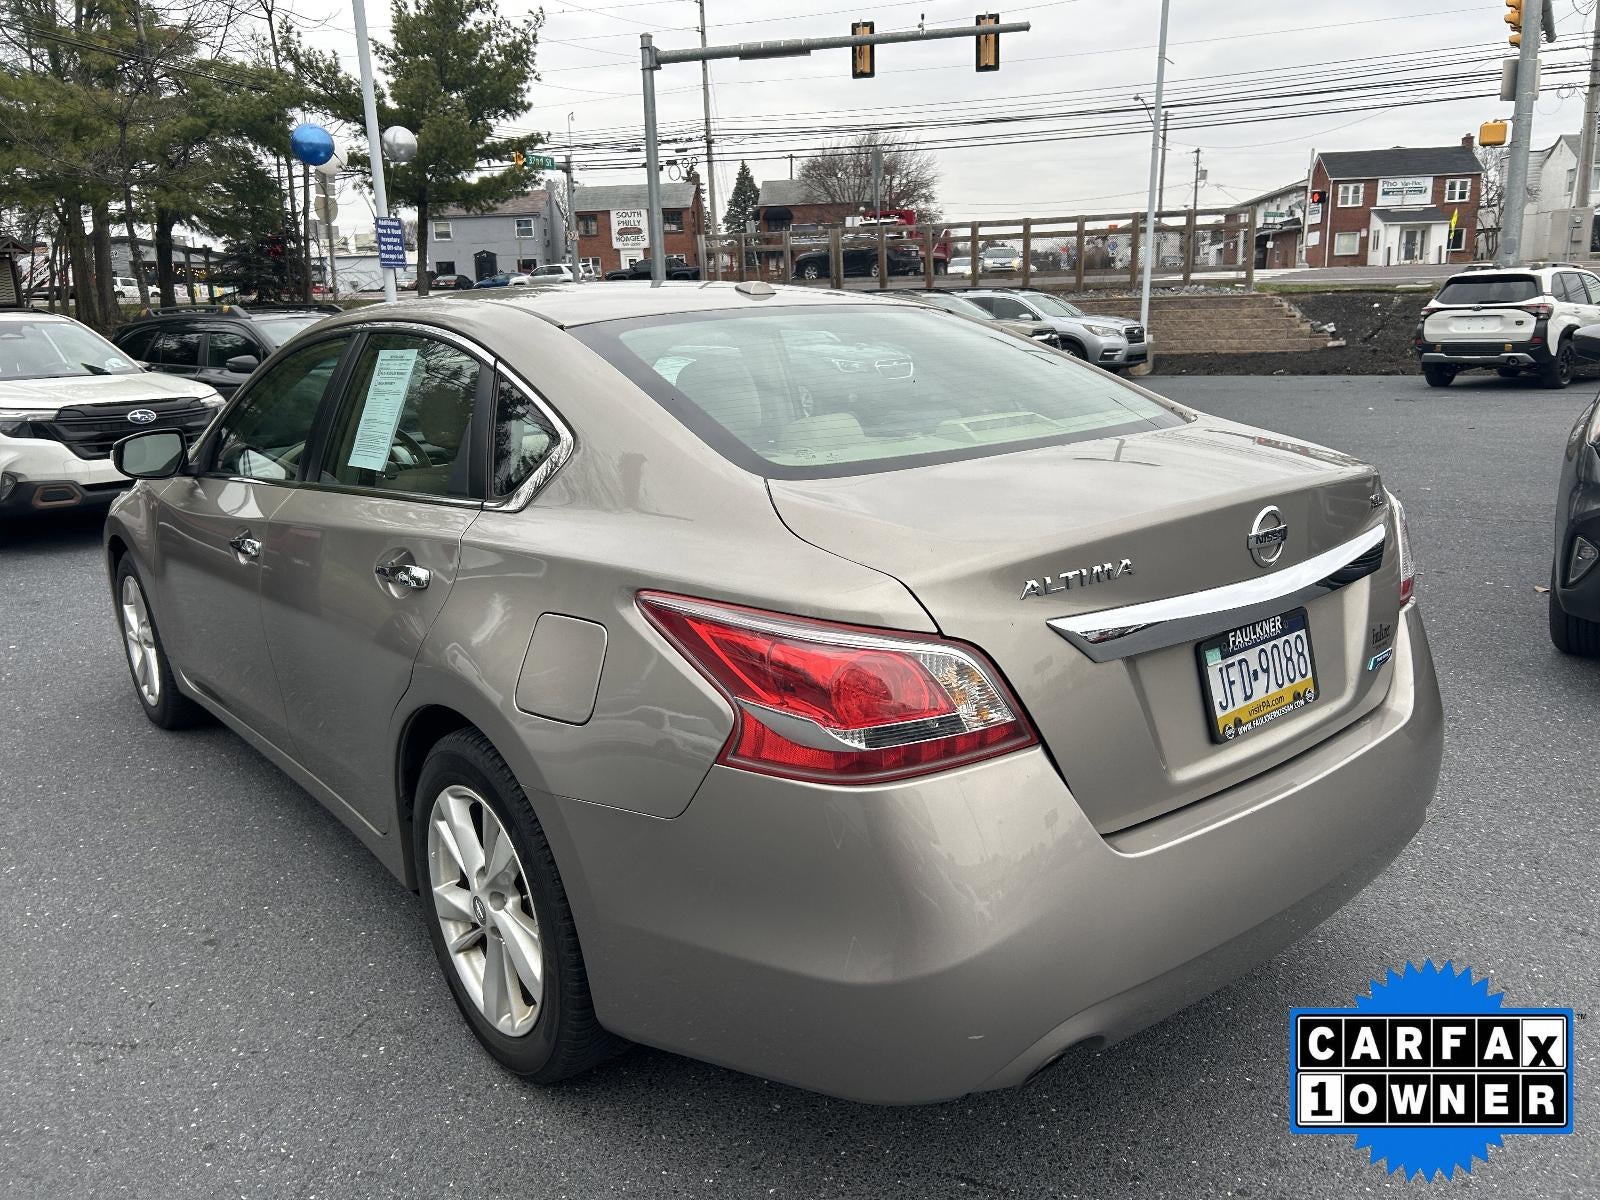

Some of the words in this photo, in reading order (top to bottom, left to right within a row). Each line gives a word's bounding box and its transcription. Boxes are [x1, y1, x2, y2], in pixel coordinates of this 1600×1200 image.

[1381, 180, 1398, 188] Pho
[616, 211, 642, 219] SOUTH
[617, 219, 641, 227] PHILLY
[615, 234, 646, 243] HOAGIES
[1019, 558, 1133, 601] ALTIMA
[1228, 615, 1283, 651] FAULKNER
[1248, 694, 1285, 717] visitPA.com
